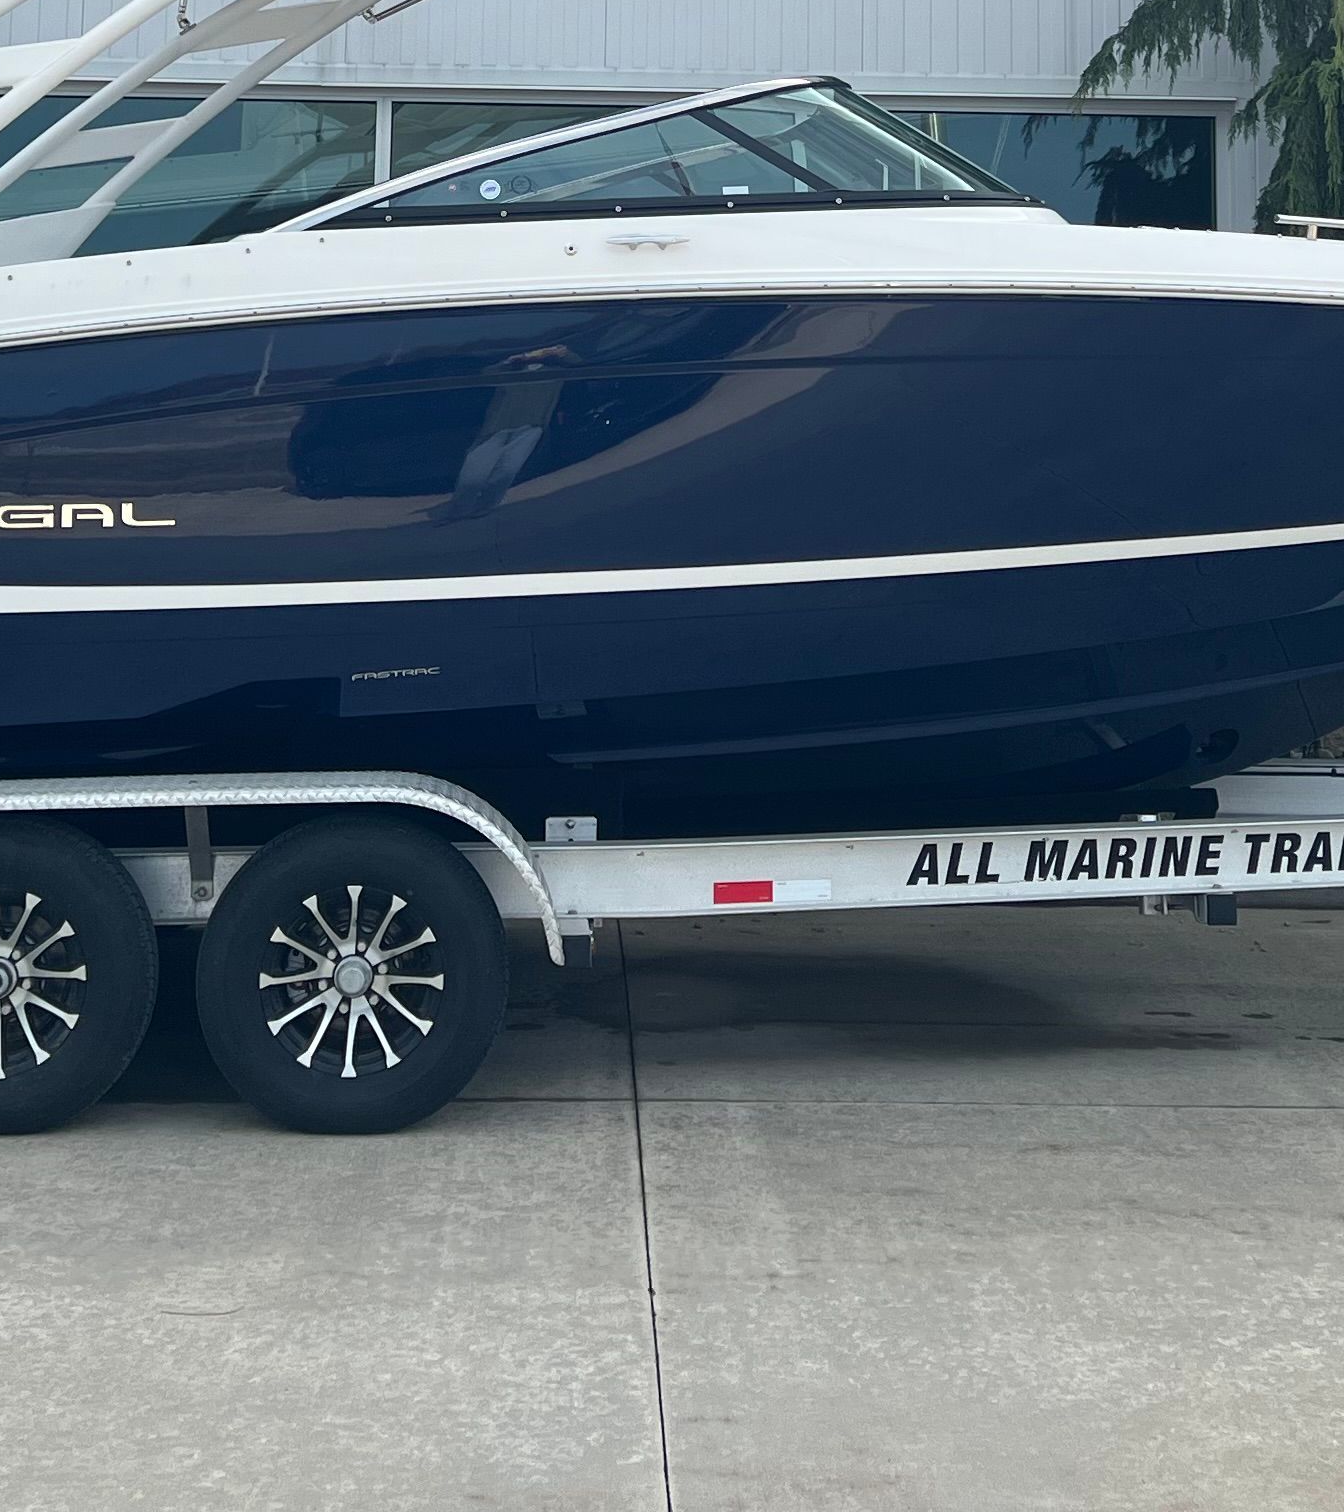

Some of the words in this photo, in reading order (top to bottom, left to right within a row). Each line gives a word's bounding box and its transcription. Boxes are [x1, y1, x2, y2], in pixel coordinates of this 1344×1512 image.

[351, 666, 441, 682] FASTRAC
[906, 841, 1000, 886] ALL
[1023, 834, 1224, 882] MARINE
